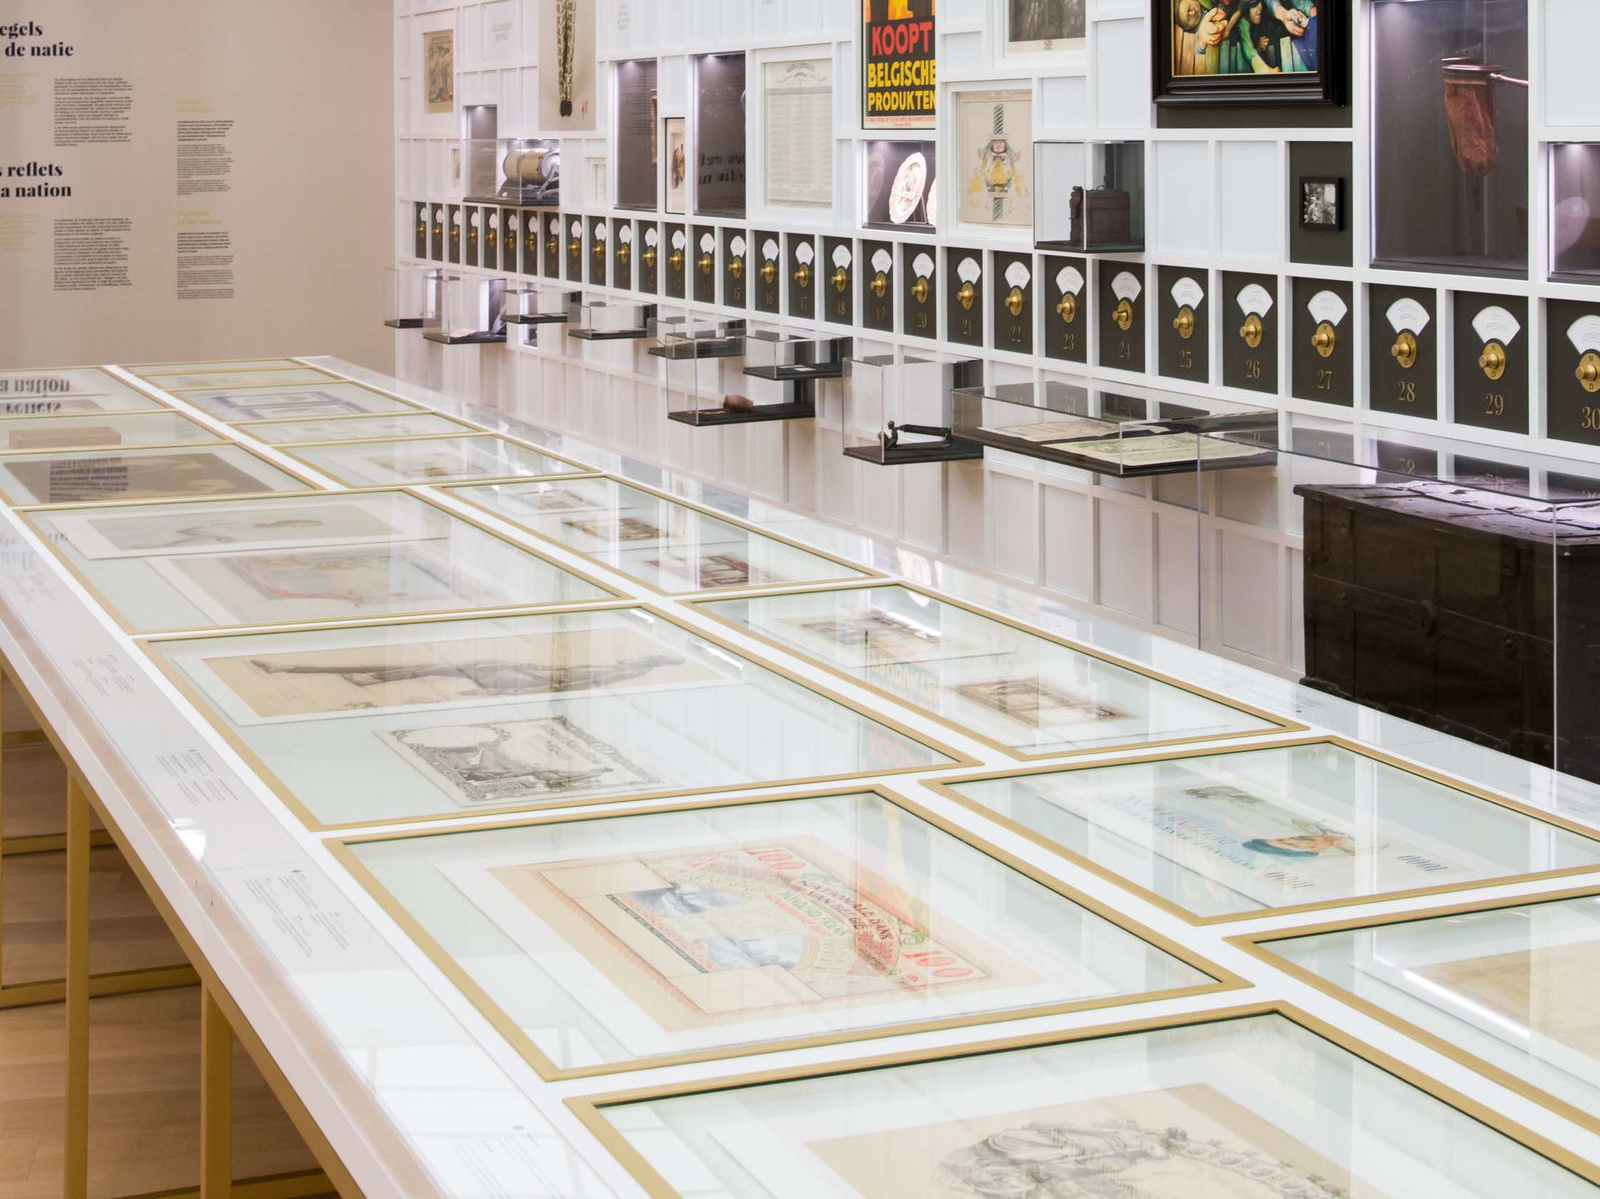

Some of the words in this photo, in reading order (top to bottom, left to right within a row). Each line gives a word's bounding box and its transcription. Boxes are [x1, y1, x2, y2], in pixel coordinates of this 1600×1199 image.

[872, 21, 933, 56] KOOPT
[5, 42, 26, 57] de
[30, 42, 74, 57] natie
[868, 60, 936, 87] BELGISCHE
[868, 90, 936, 111] PRODUKTEN
[7, 161, 63, 177] reflets
[1, 186, 10, 198] a
[15, 183, 72, 198] nation
[837, 301, 846, 315] 18
[916, 312, 927, 329] 20
[962, 319, 972, 336] 21
[1011, 325, 1022, 343] 22
[1063, 333, 1075, 351] 23
[1119, 341, 1131, 359] 24
[1179, 349, 1192, 369] 25
[1245, 359, 1260, 379] 26
[1317, 369, 1334, 390] 27
[1398, 381, 1415, 402] 28
[1485, 393, 1504, 417] 29
[1581, 406, 1600, 431] 30
[747, 849, 807, 870] 100
[903, 950, 973, 978] 100
